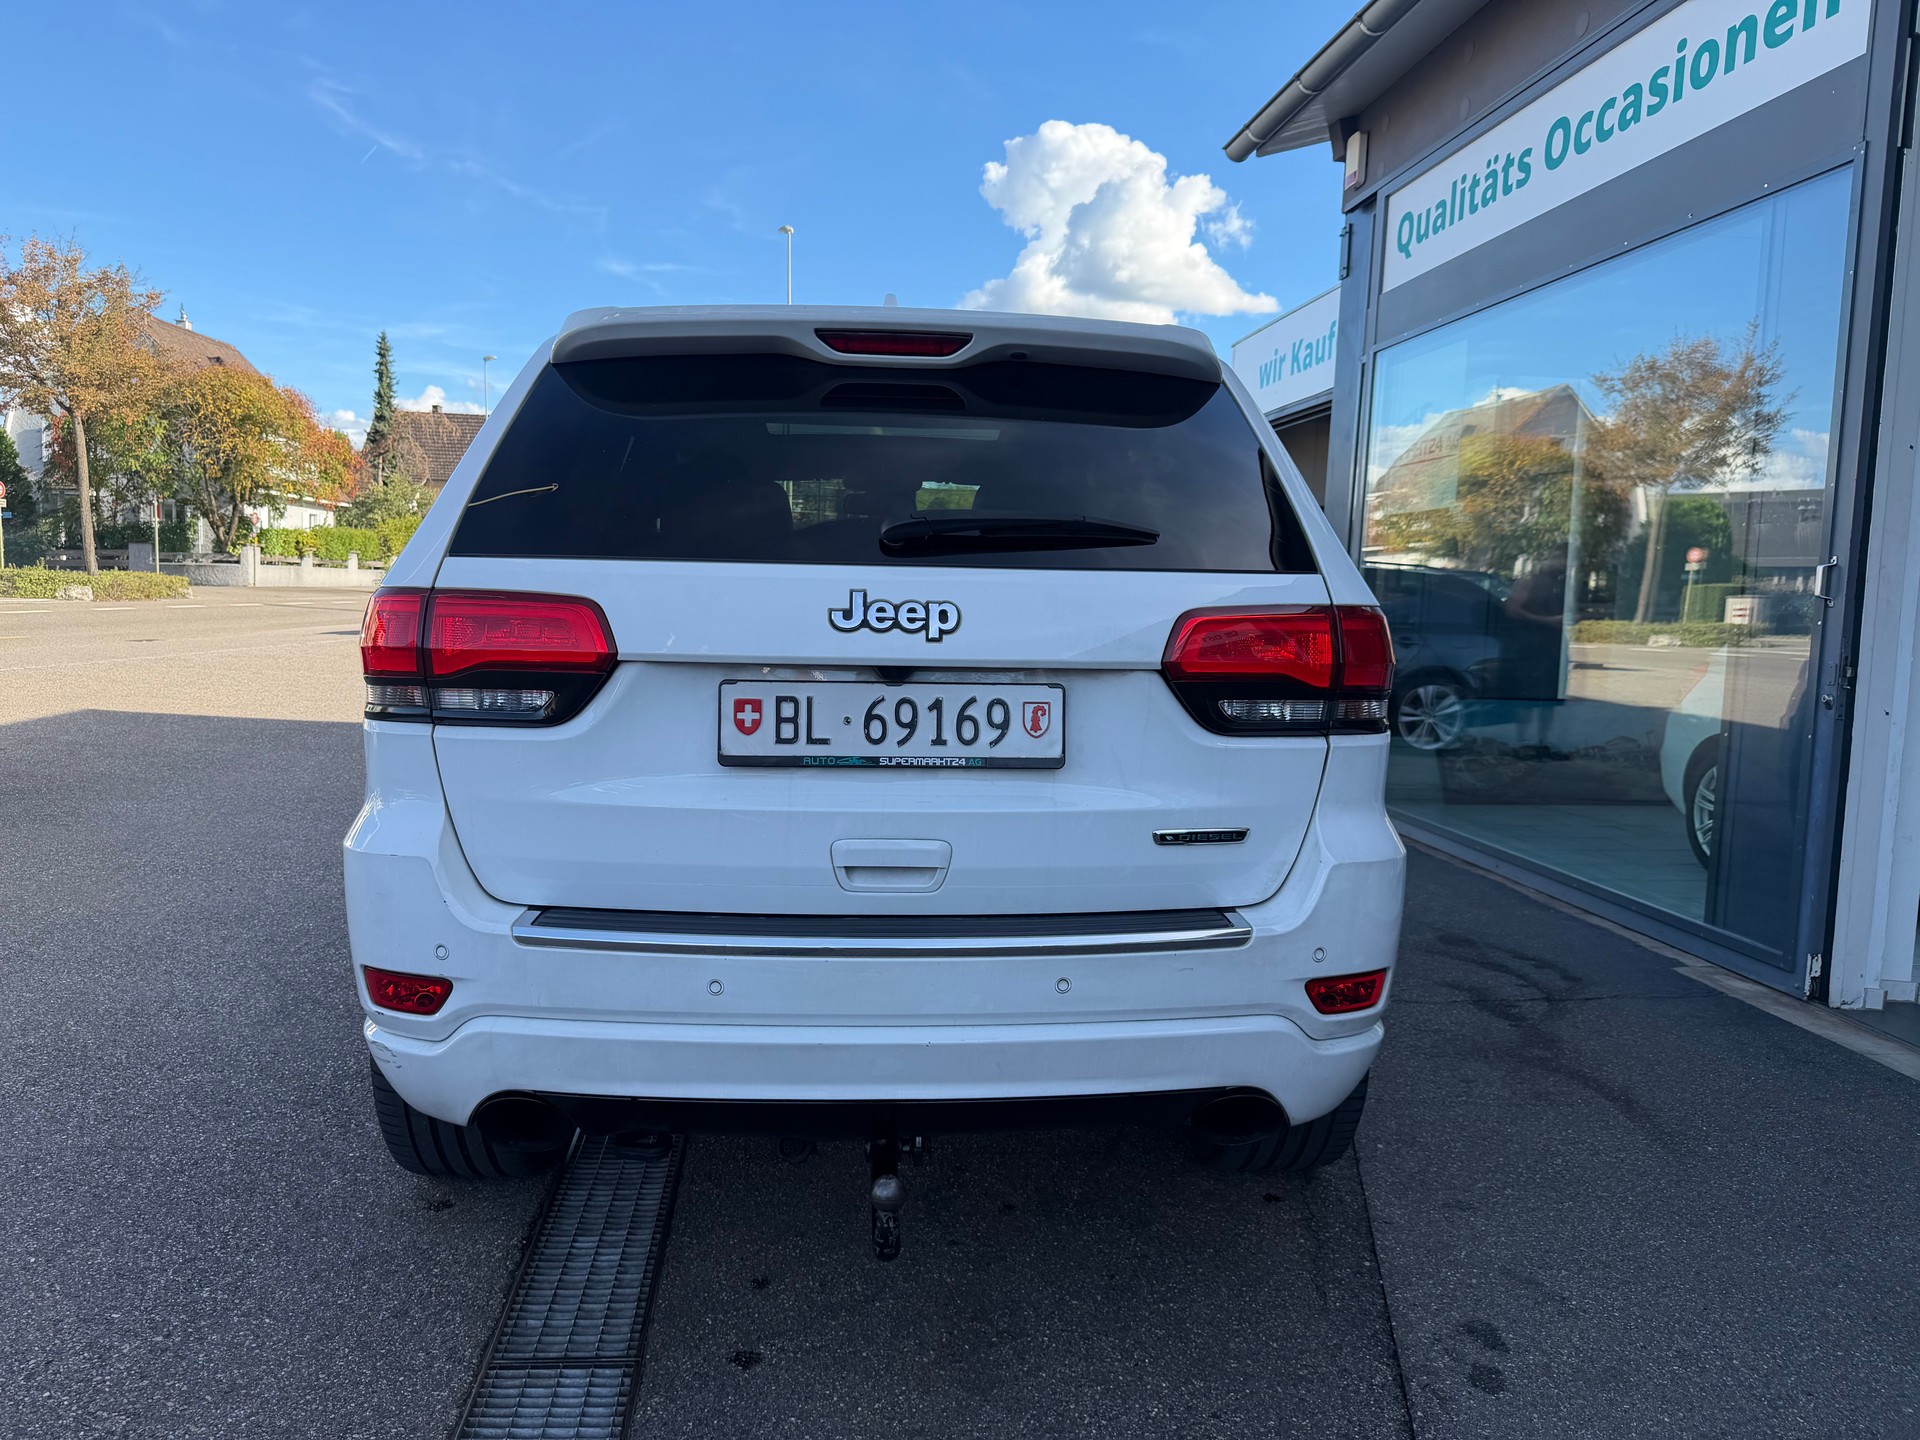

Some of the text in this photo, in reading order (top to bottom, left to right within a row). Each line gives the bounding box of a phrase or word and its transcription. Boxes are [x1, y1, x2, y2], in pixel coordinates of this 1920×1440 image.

[1397, 147, 1533, 259] Qualitäts
[1259, 319, 1337, 389] wir Kauf
[828, 589, 961, 643] Jeep
[774, 694, 1011, 748] BL 69169
[803, 756, 983, 767] AUTO SUPERMARKT24 AG
[1178, 832, 1243, 842] DIESEL
